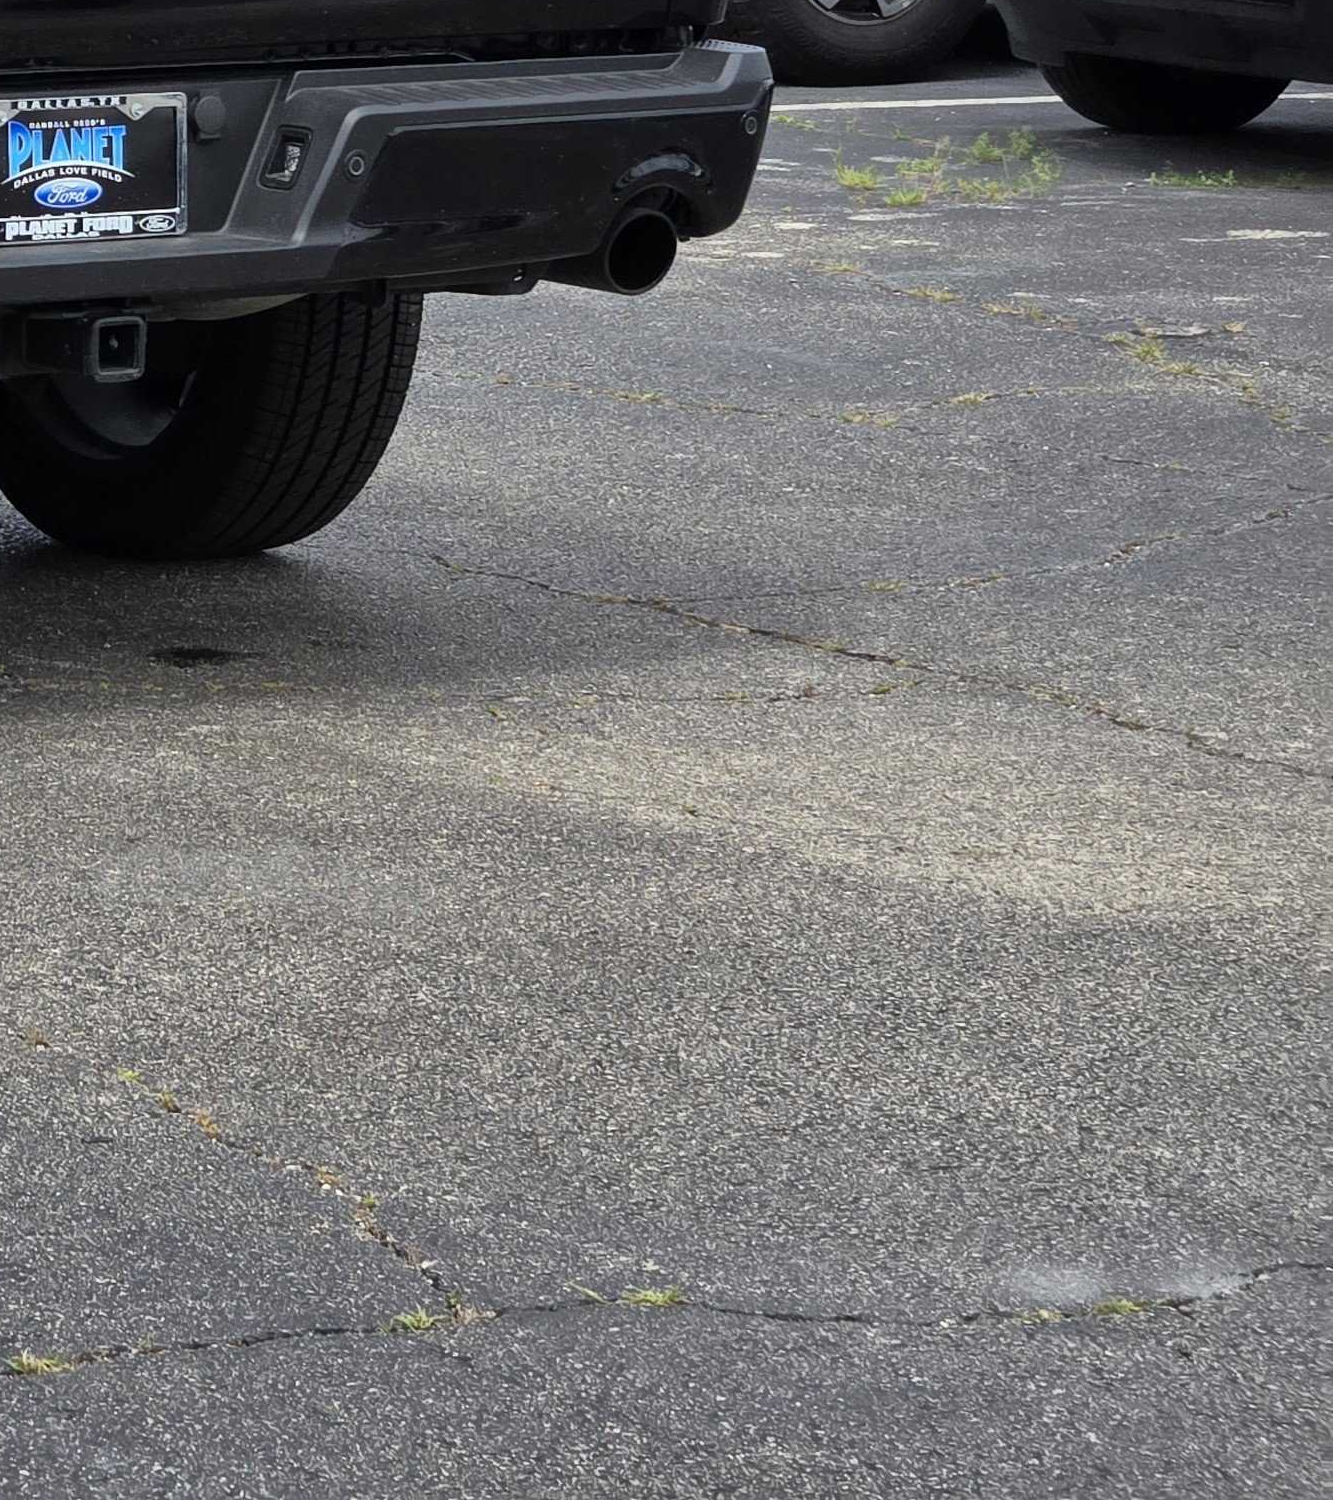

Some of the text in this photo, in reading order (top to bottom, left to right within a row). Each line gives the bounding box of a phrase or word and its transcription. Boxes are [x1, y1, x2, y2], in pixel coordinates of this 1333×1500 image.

[7, 120, 126, 179] PLANET
[14, 166, 123, 189] DALLAS LOVE FIELD
[47, 184, 87, 203] Ford
[5, 216, 133, 241] PLANET FORD
